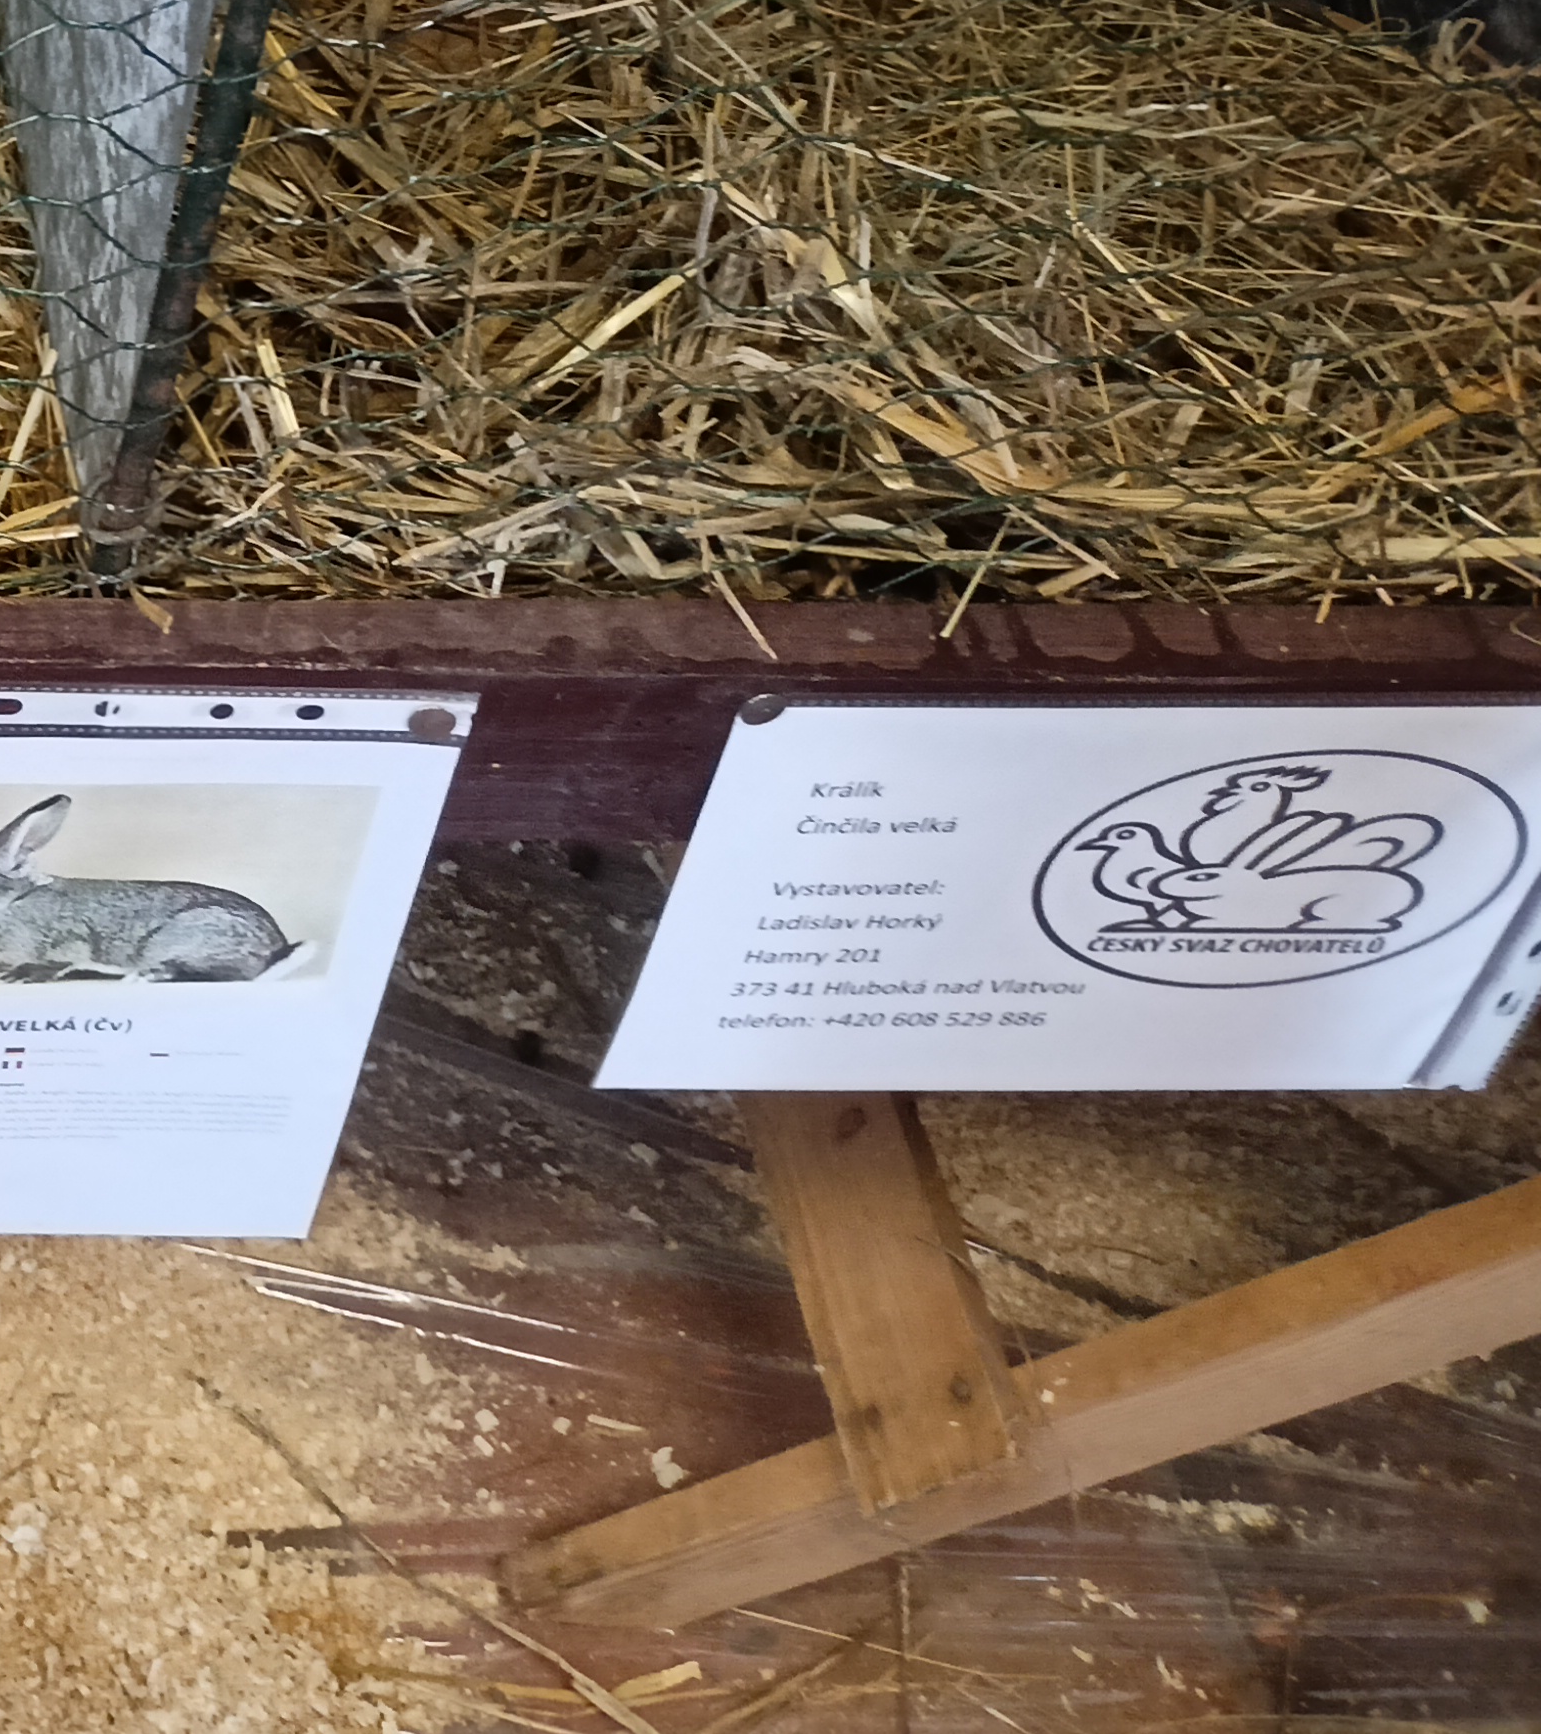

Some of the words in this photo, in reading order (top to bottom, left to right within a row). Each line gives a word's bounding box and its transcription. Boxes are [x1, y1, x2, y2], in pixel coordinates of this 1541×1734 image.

[810, 781, 885, 798] Králík
[796, 815, 881, 834] Činčila
[890, 816, 958, 834] velká
[773, 879, 946, 901] Vystavovatel:
[757, 914, 859, 931] Ladislav
[865, 913, 944, 932] Horký
[1087, 935, 1165, 953] ČESKÝ
[1169, 937, 1232, 953] SVAZ
[1238, 935, 1387, 954] CHOVATELŮ
[743, 948, 829, 966] Hamry
[835, 948, 882, 963] 201
[729, 981, 778, 997] 373
[783, 981, 814, 996] 41
[823, 980, 928, 996] Hluboká
[933, 979, 984, 995] nad
[718, 1012, 815, 1029] telefon:
[824, 1012, 885, 1028] +420
[891, 1012, 940, 1028] 608
[944, 1011, 993, 1027] 529
[997, 1011, 1048, 1027] 886
